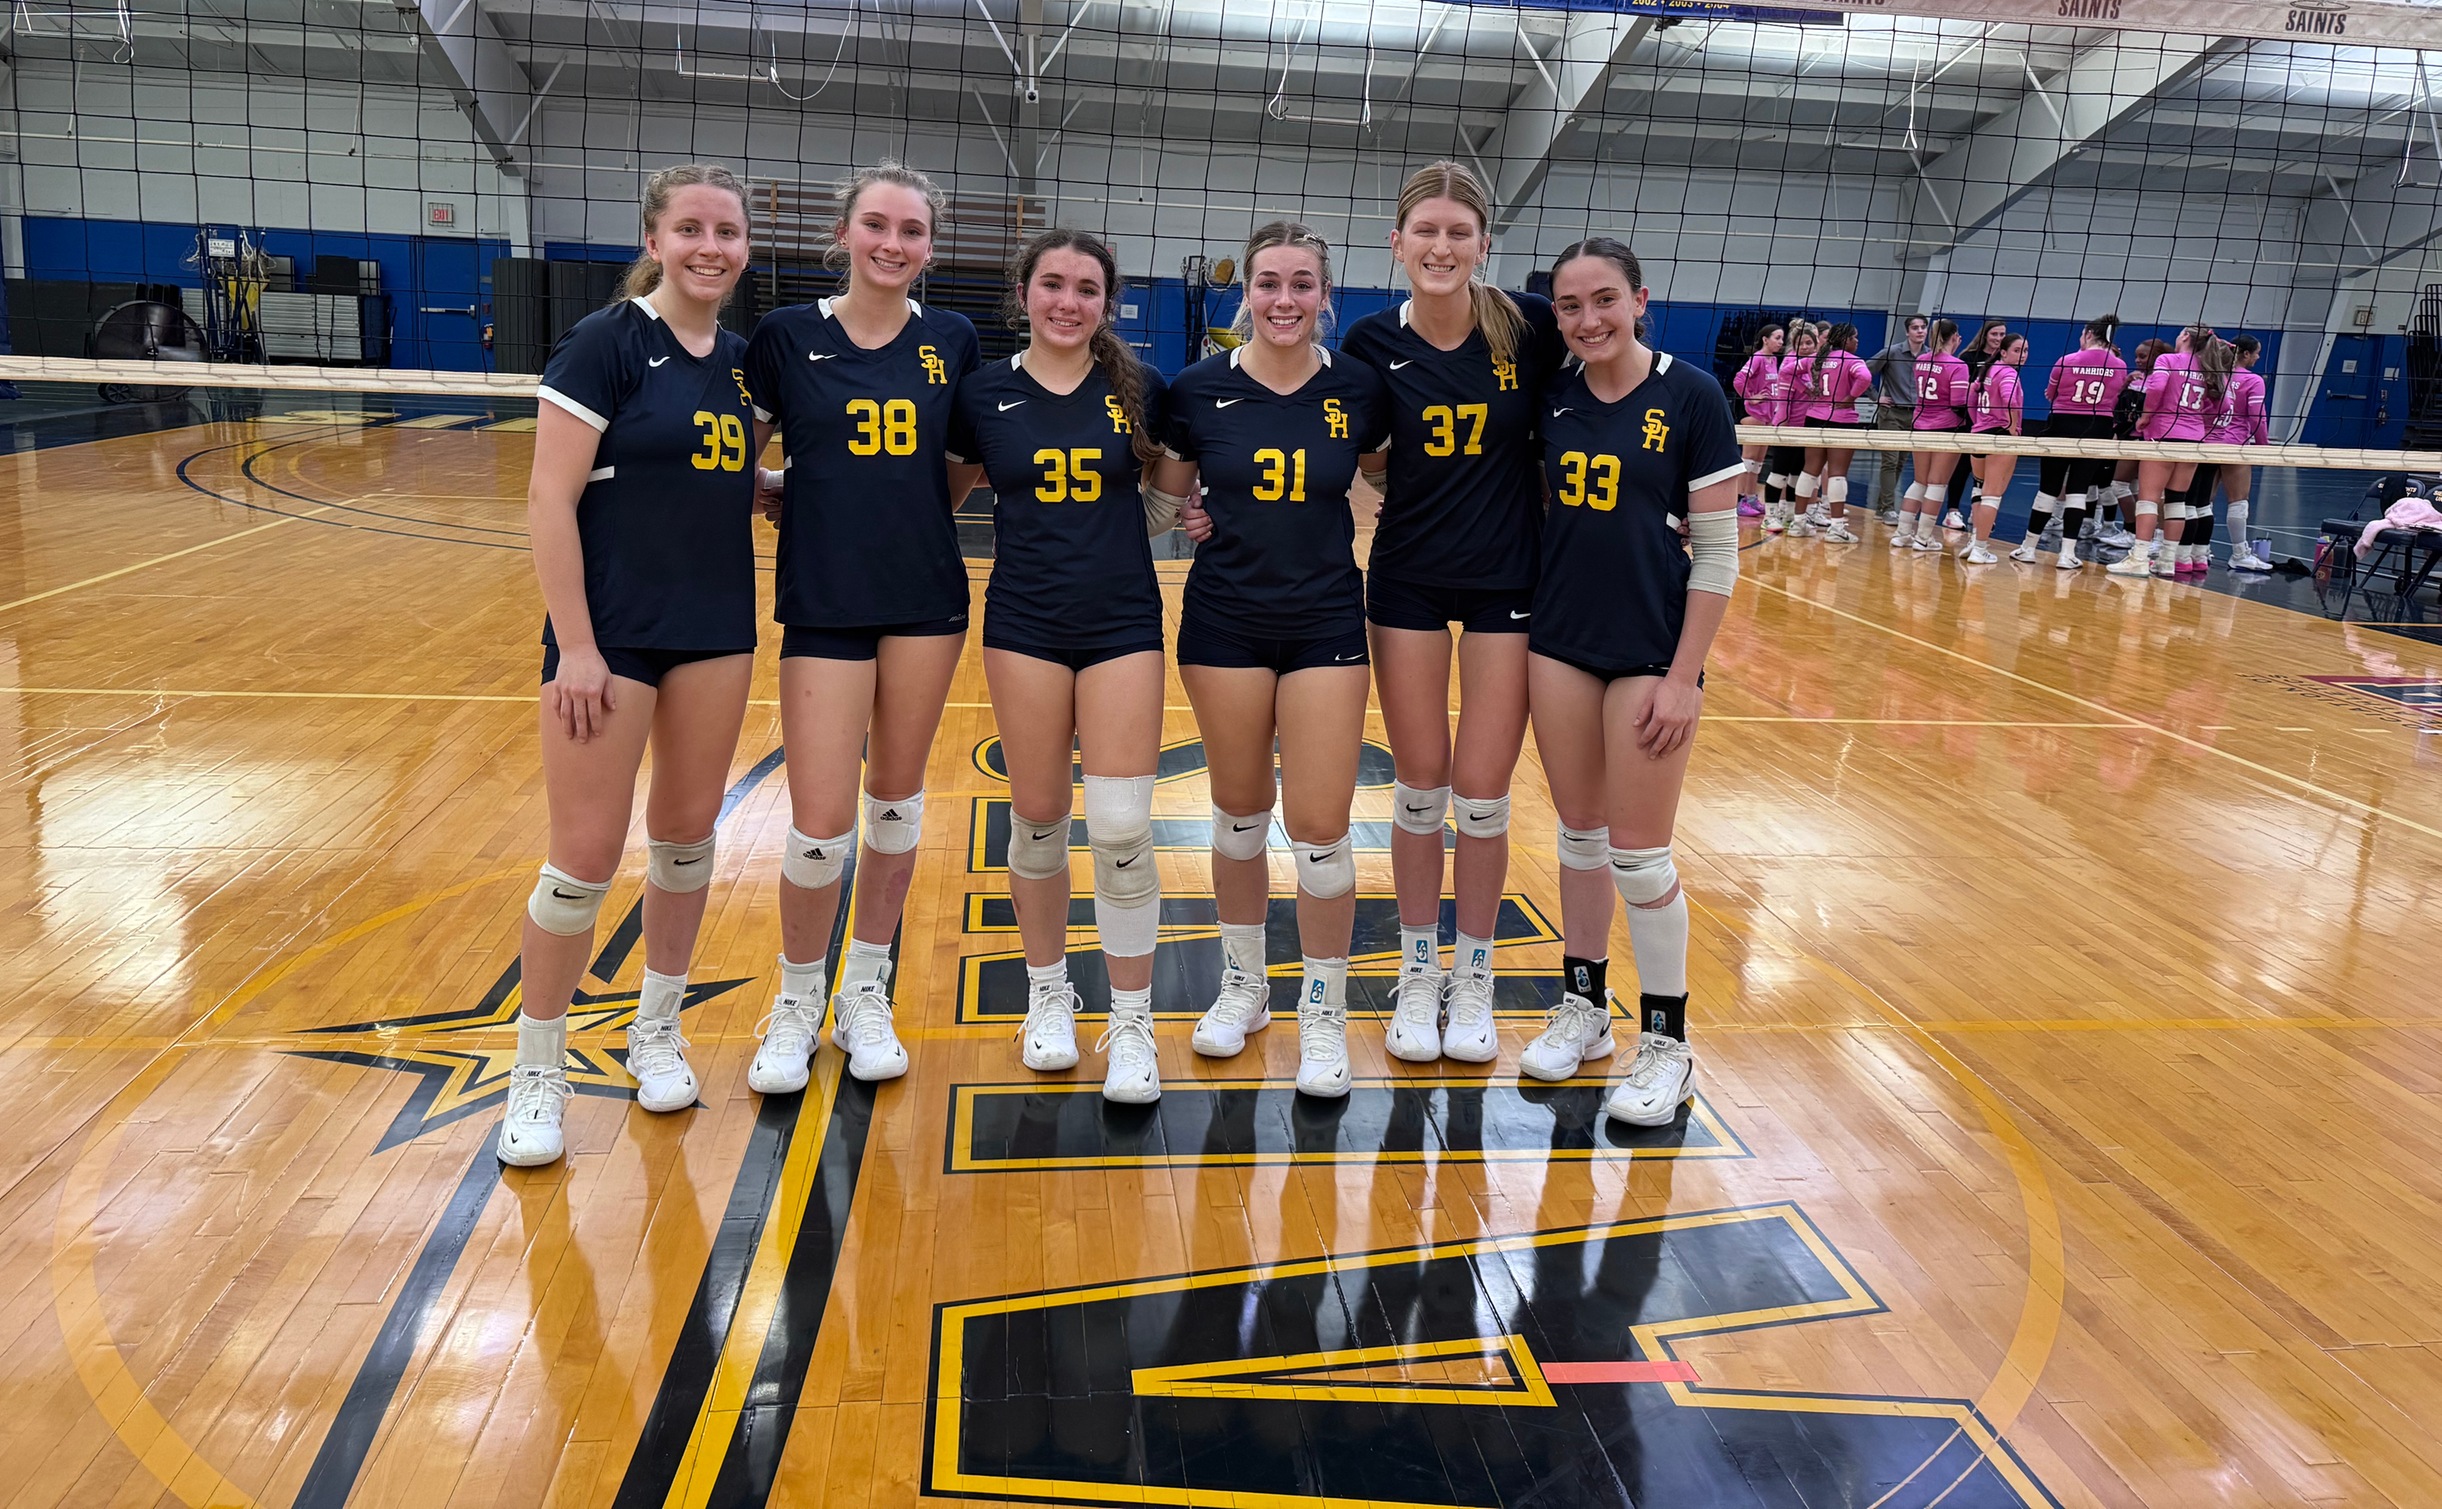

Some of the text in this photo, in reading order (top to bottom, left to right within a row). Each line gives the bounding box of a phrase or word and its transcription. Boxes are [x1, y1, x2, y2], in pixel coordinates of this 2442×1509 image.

[2057, 0, 2121, 19] SAINTS
[2284, 10, 2347, 35] SAINTS
[2072, 367, 2114, 378] WARRIORS
[1917, 376, 1938, 400] 12
[2071, 380, 2105, 404] 19
[2179, 382, 2205, 410] 17
[845, 398, 917, 456] 38
[1422, 403, 1488, 457] 37
[691, 410, 747, 472] 39
[1033, 448, 1102, 502] 35
[1252, 447, 1306, 502] 31
[1558, 450, 1622, 511] 33
[803, 852, 826, 860] adidas
[1039, 984, 1051, 992] NIKE
[1473, 972, 1486, 980] NIKE
[783, 998, 798, 1006] NIKE
